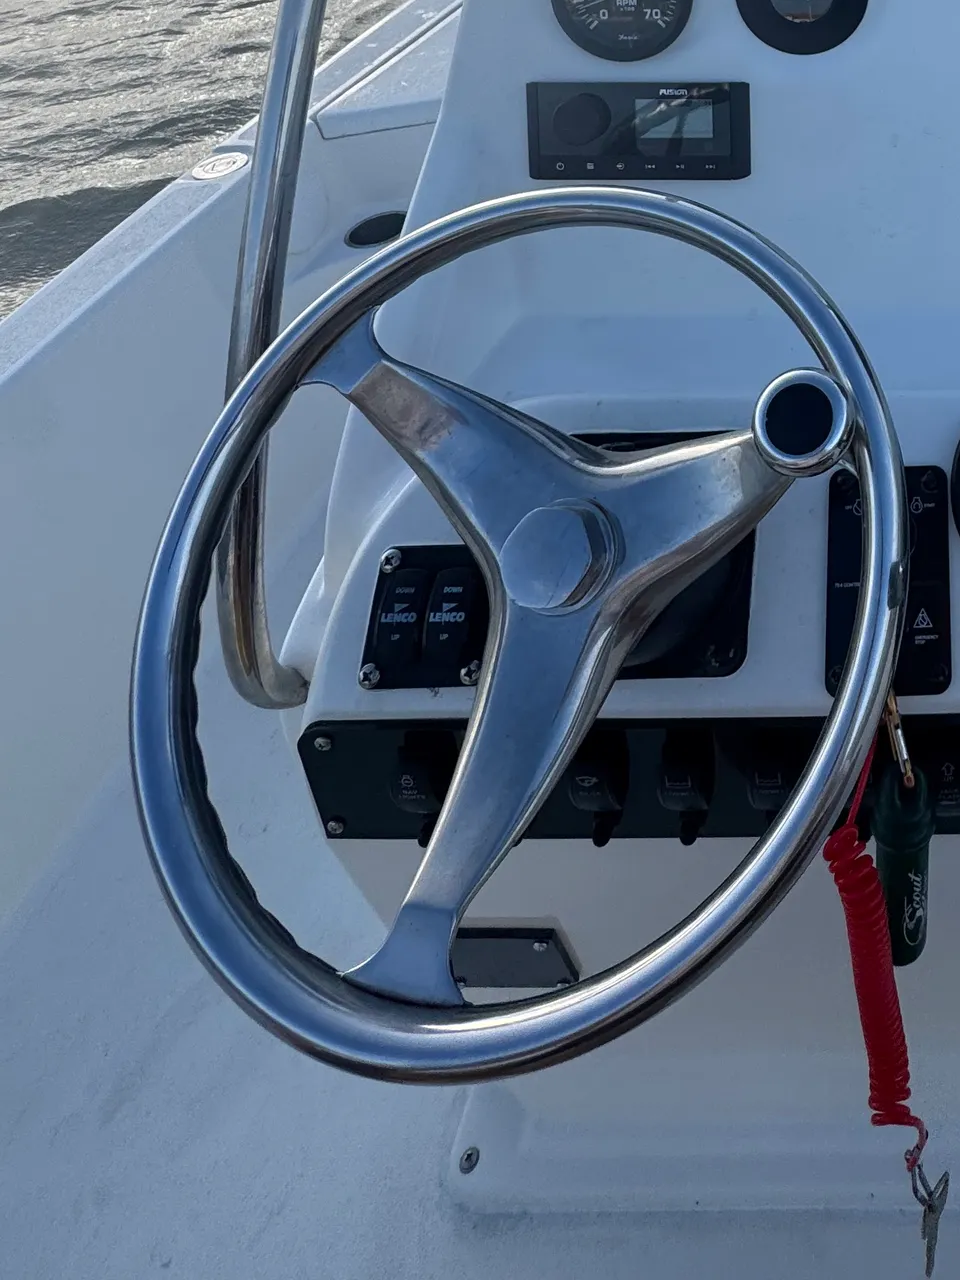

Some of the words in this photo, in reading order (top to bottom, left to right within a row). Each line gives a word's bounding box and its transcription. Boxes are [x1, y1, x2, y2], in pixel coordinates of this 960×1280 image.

[600, 9, 608, 19] 0
[643, 9, 661, 19] 70
[380, 612, 417, 622] LENCO
[429, 612, 465, 622] LENCO
[903, 868, 924, 946] Scout
